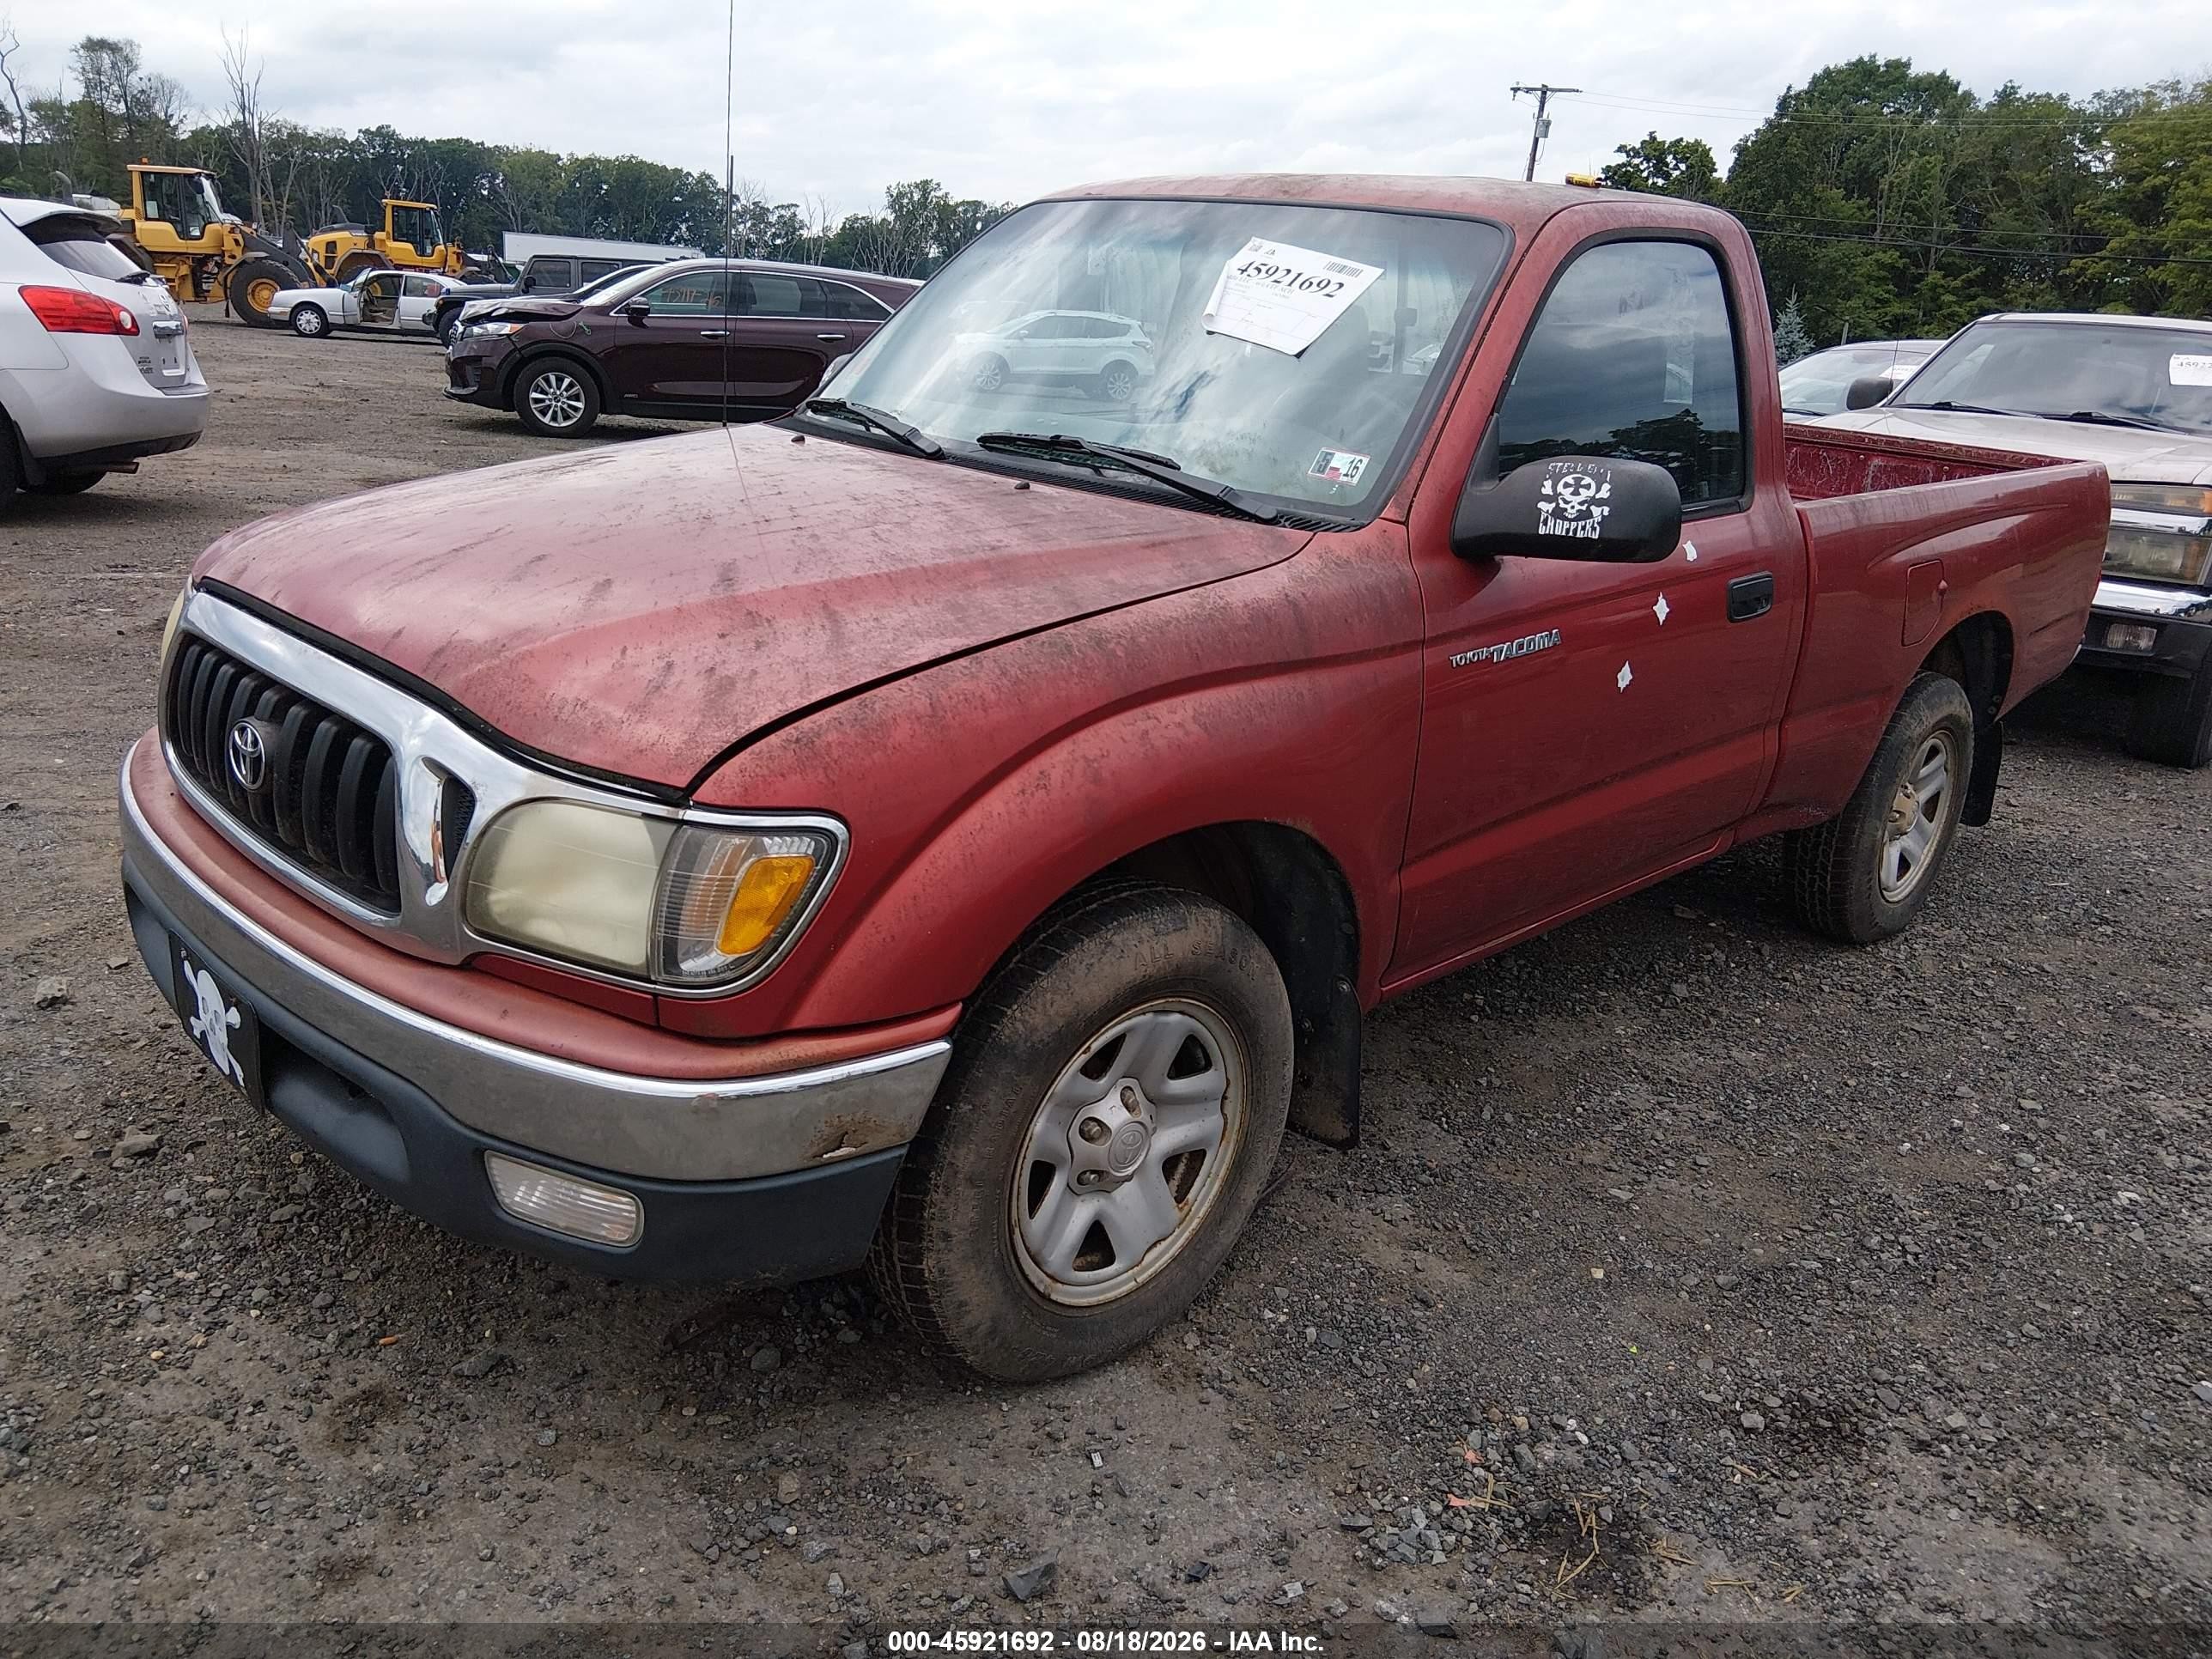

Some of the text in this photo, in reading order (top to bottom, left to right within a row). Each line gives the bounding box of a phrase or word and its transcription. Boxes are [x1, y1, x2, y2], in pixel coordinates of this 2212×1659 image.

[1237, 260, 1345, 298] 45921692
[1342, 457, 1363, 478] 16
[1538, 511, 1602, 539] CHOPPERS
[1449, 629, 1561, 667] TOYOTA TACOMA
[1134, 945, 1174, 970] ALL
